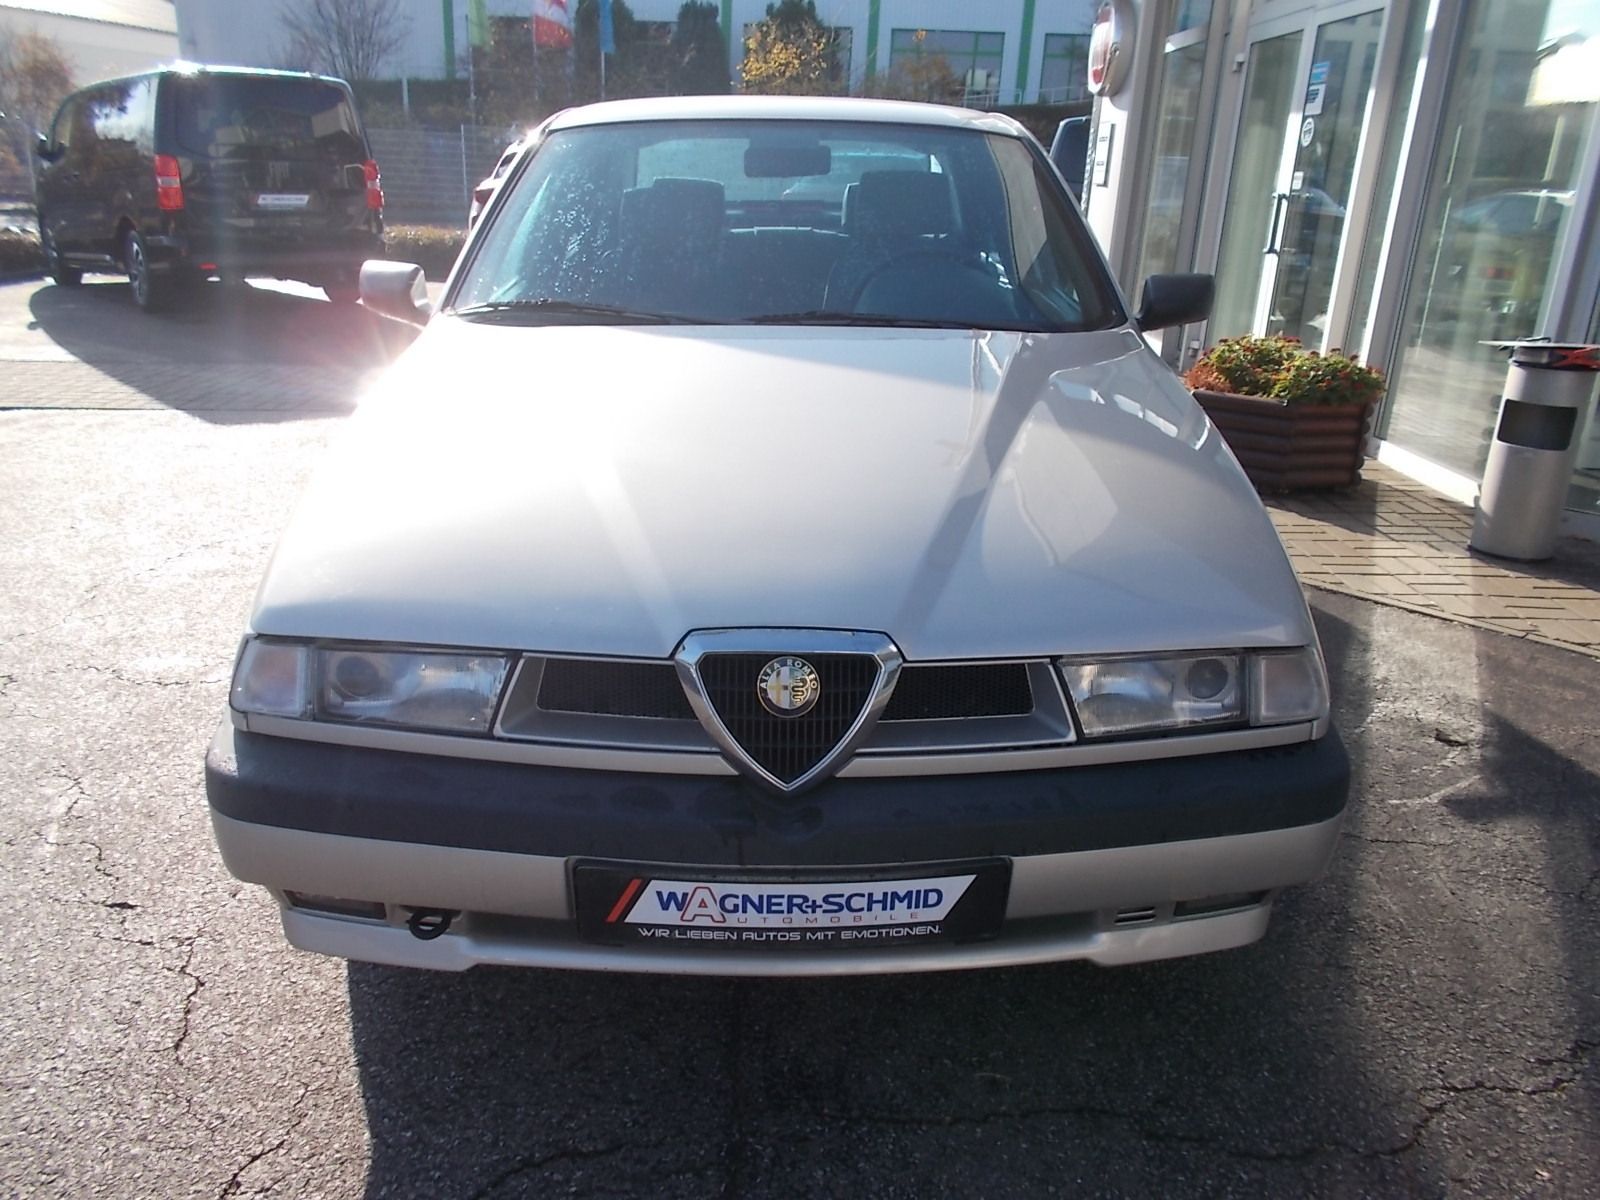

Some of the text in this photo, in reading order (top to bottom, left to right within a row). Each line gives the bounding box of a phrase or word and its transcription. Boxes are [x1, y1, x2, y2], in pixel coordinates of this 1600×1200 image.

[760, 659, 818, 689] ALFA ROMEO
[638, 925, 942, 941] WIR LIEBEN AUTOS MIT EMOTIONEN.
